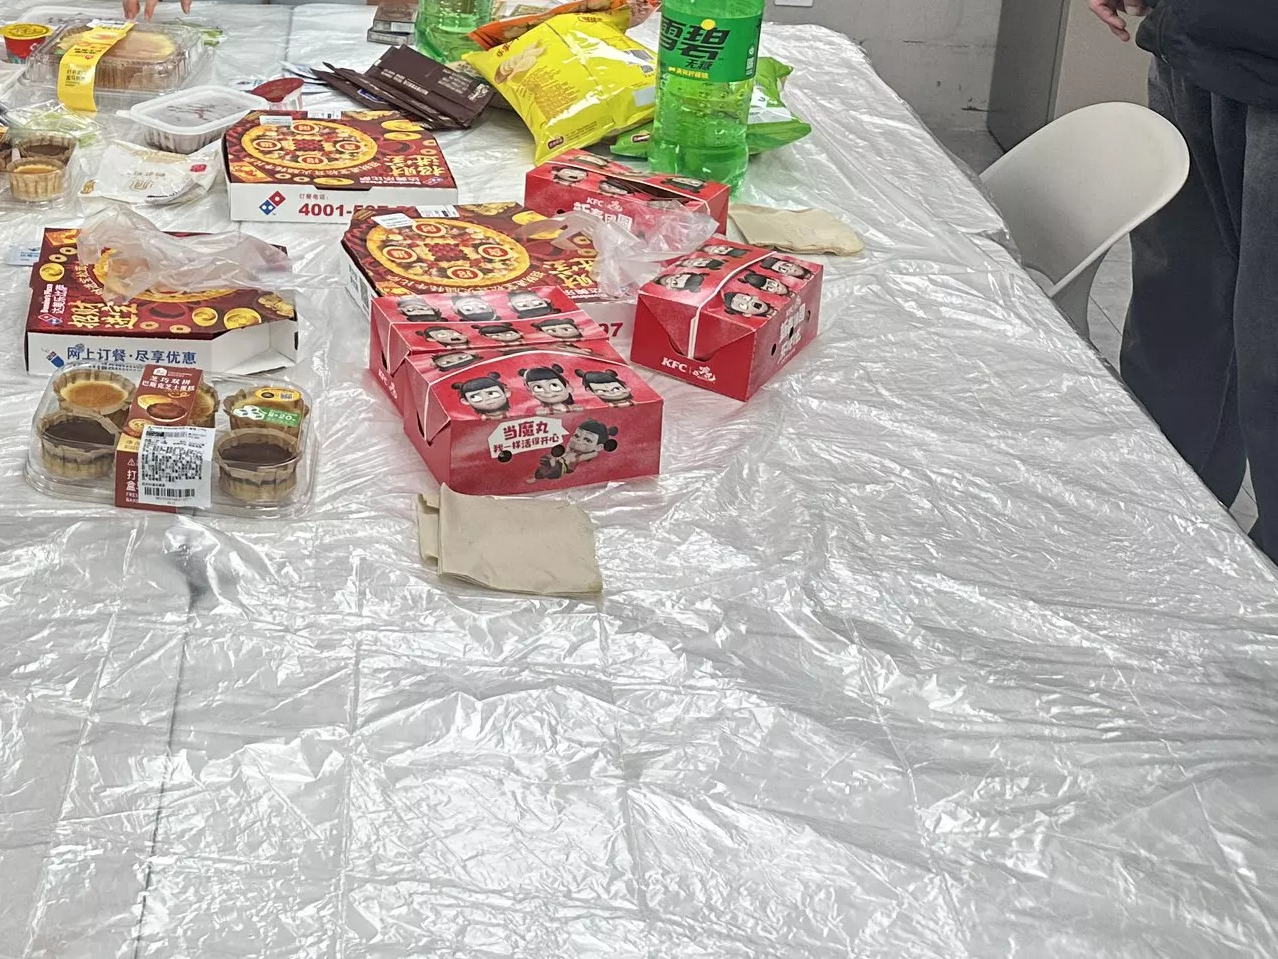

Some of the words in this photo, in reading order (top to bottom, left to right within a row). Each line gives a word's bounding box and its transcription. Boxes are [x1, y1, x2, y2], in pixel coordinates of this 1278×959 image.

[660, 16, 731, 61] 雪碧
[586, 196, 604, 208] KFC
[661, 356, 689, 373] KFC
[502, 420, 550, 440] 当魔丸
[493, 433, 560, 453] 我一样活得开心
